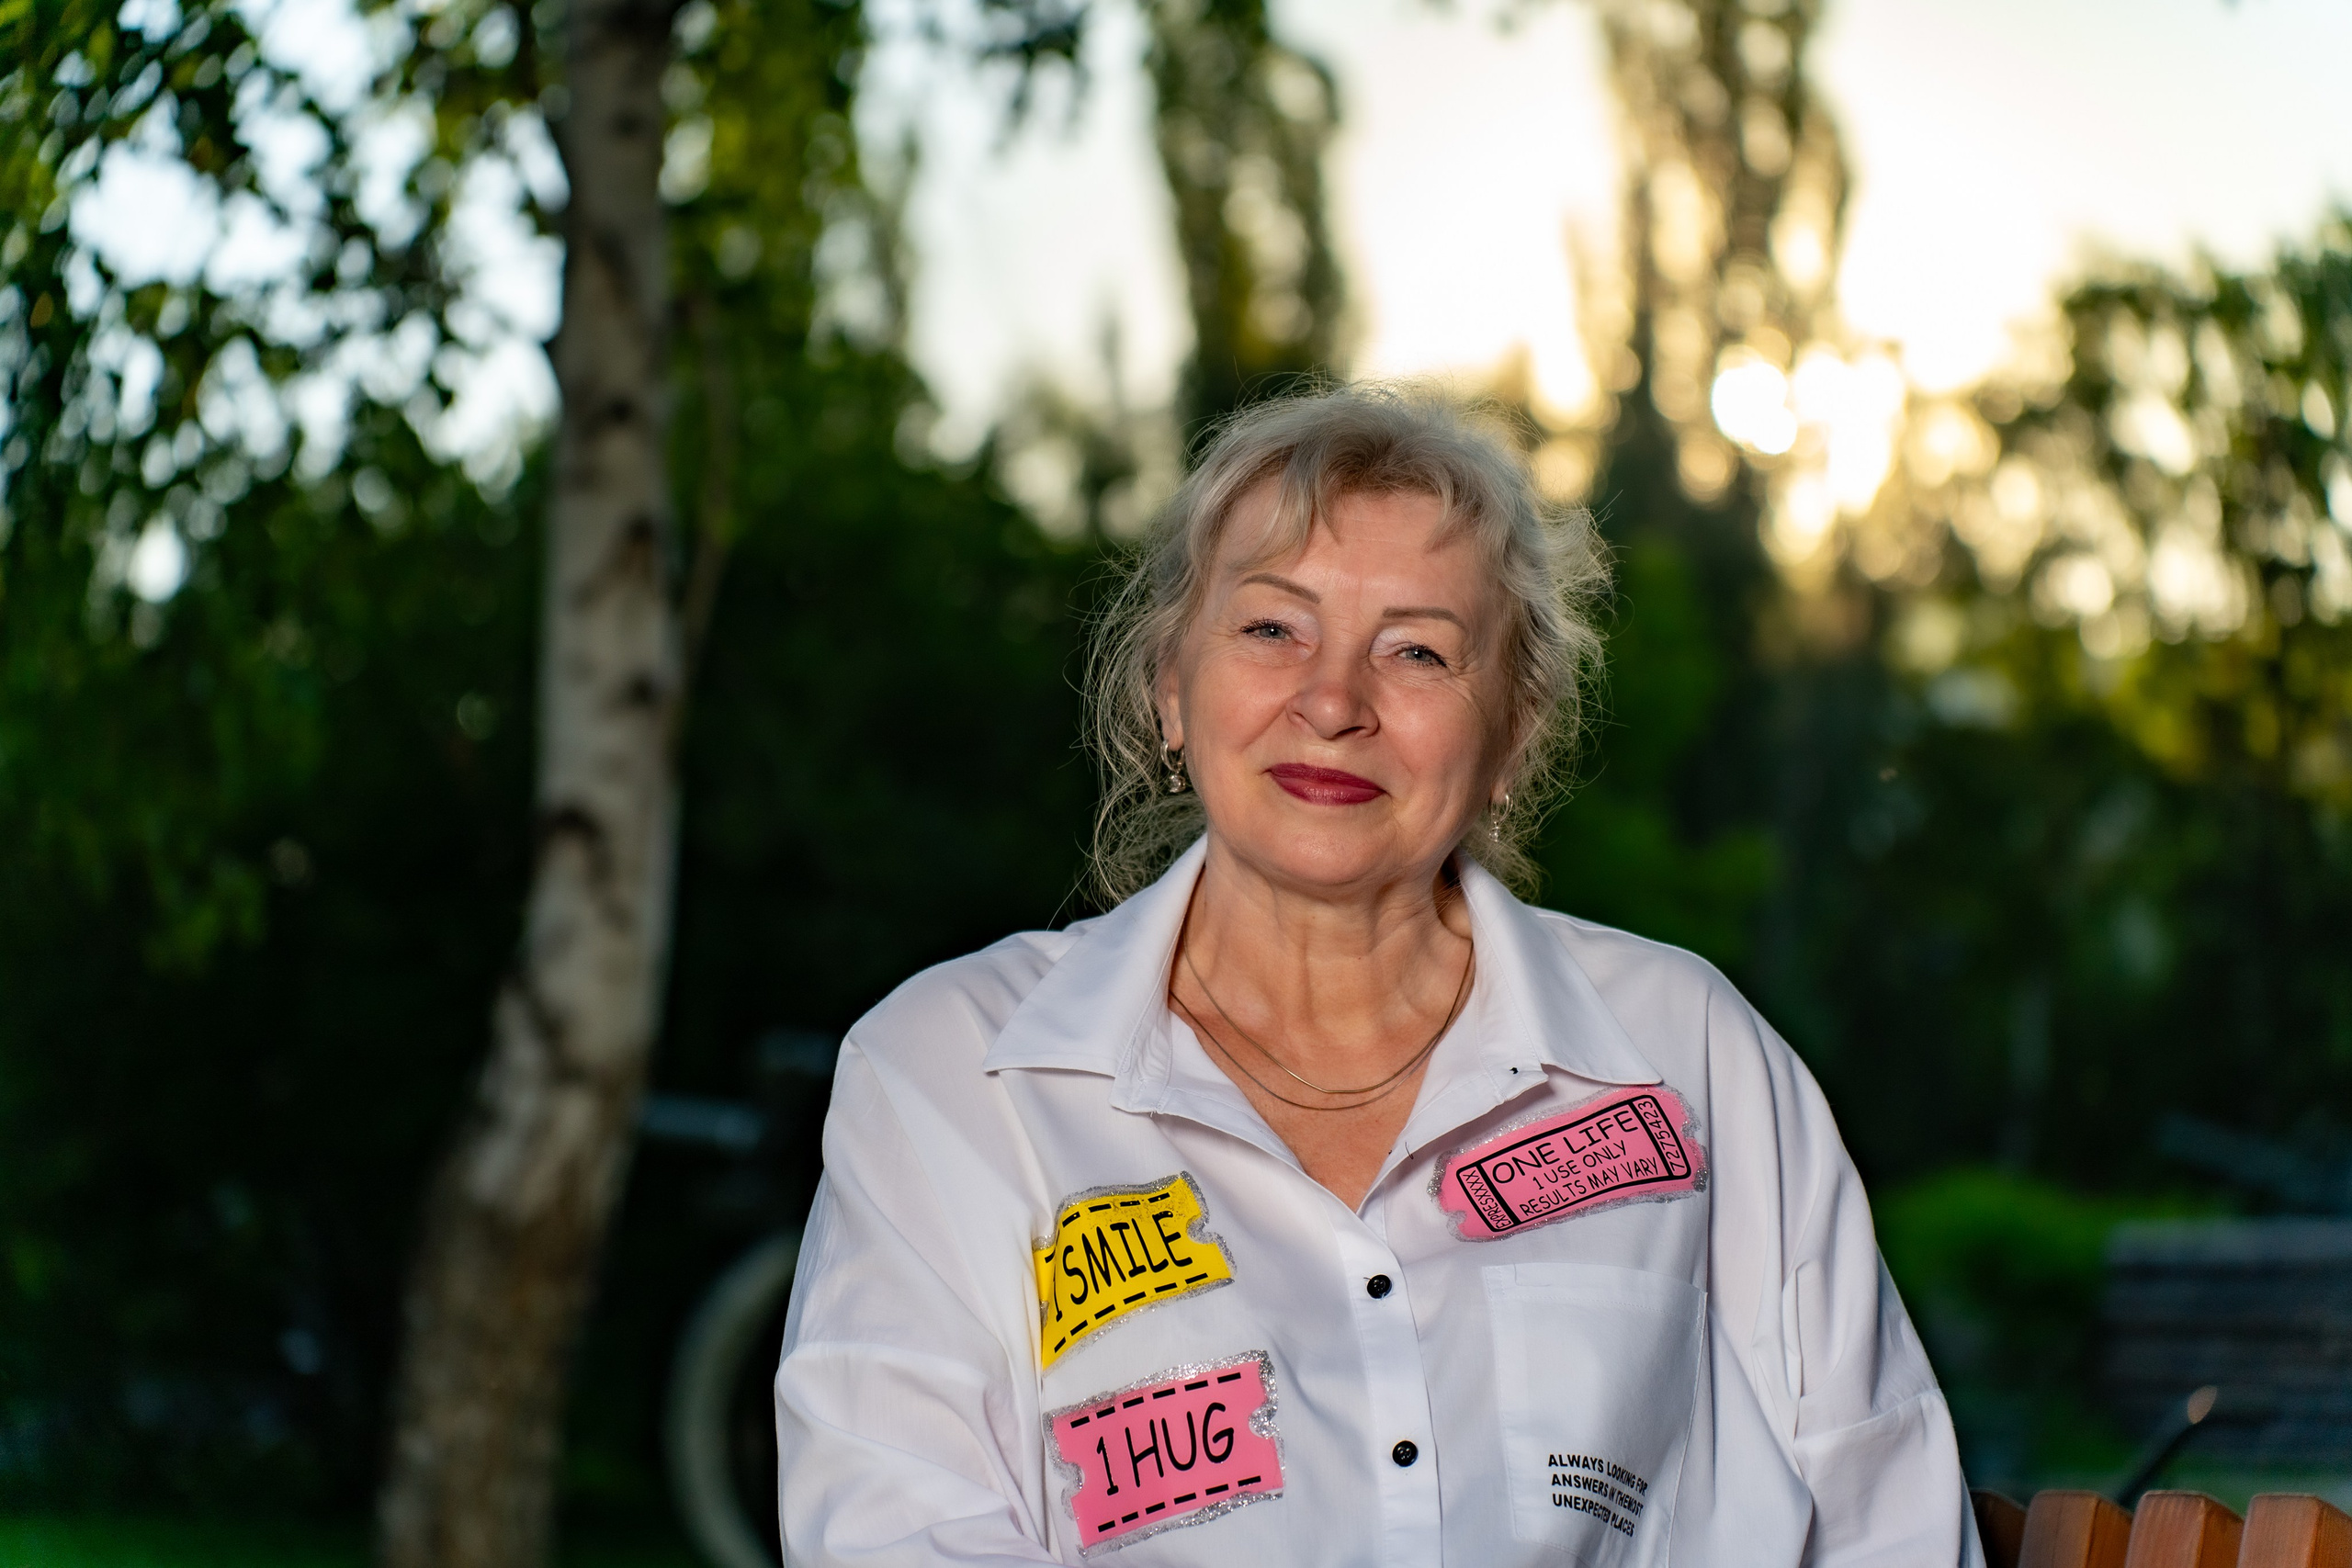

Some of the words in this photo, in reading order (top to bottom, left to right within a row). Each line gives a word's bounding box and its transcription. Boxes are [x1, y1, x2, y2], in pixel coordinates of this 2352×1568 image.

[1493, 1143, 1559, 1184] ONE
[1563, 1110, 1638, 1155] LIFE
[1532, 1176, 1544, 1190] 1
[1544, 1161, 1579, 1184] USE
[1583, 1140, 1626, 1168] ONLY
[1638, 1101, 1685, 1171] 7275423
[1519, 1179, 1588, 1216] RESULTS
[1589, 1168, 1619, 1191] MAY
[1621, 1156, 1659, 1179] VARY
[1062, 1211, 1193, 1305] SMILE
[1096, 1436, 1119, 1496] 1
[1125, 1402, 1234, 1488] HUG
[1548, 1454, 1604, 1473] ALWAYS
[1607, 1461, 1636, 1489] LOOKING
[1635, 1477, 1648, 1497] FOR
[1552, 1473, 1609, 1497] ANSWERS
[1608, 1486, 1617, 1502] IN
[1553, 1493, 1611, 1523] UNEXPECTED
[1611, 1513, 1634, 1538] PLACES
